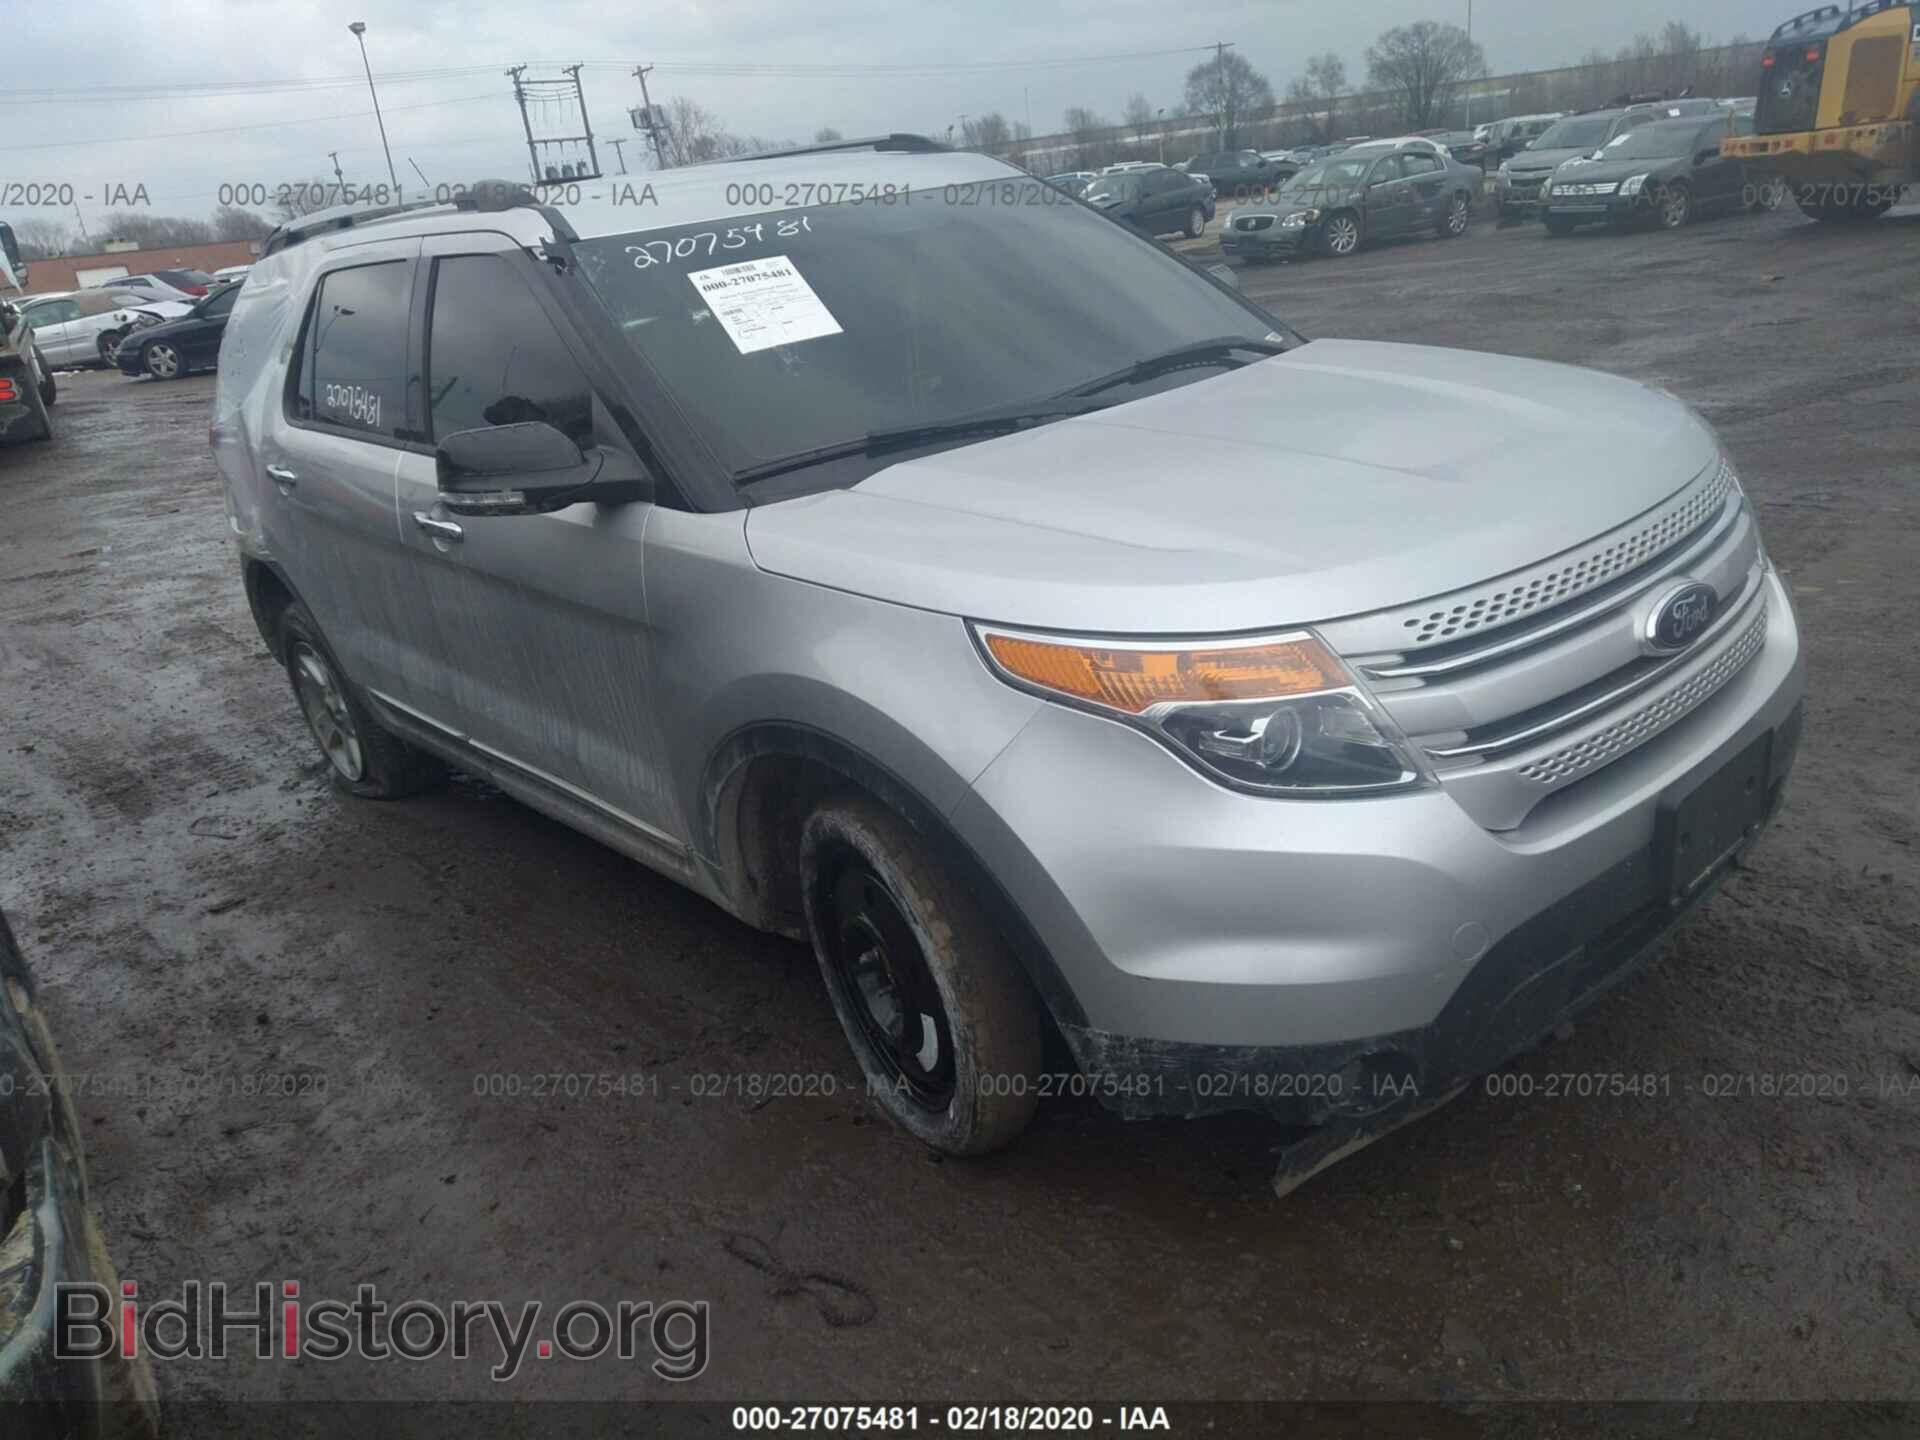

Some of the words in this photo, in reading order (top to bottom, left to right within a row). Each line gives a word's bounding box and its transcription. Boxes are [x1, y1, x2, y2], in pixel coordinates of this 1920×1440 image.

[702, 268, 792, 292] 000-27075481
[327, 384, 381, 427] 27075481
[1673, 593, 1709, 637] Ford
